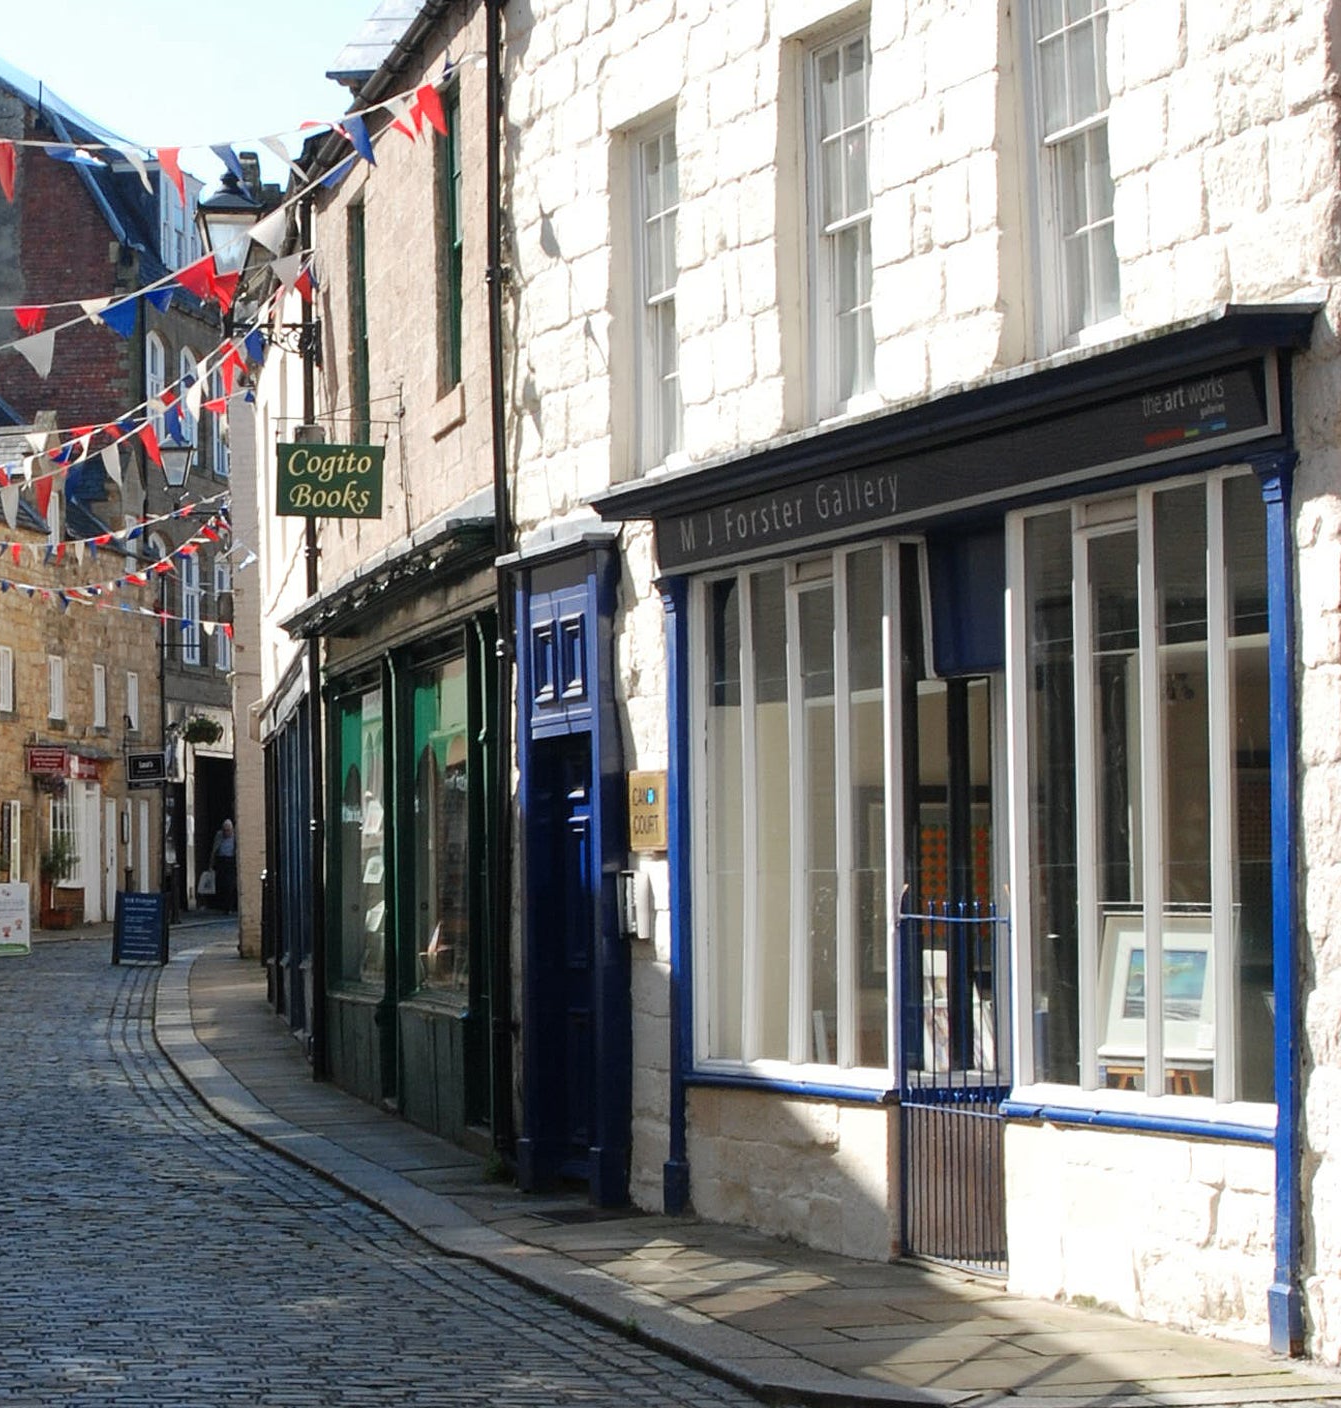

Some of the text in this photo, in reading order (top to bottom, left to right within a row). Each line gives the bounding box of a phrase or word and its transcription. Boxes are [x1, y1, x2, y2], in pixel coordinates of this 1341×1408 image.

[1142, 377, 1225, 417] the art works
[288, 448, 372, 482] Cogito
[289, 480, 370, 514] Books
[680, 473, 898, 551] M J Forster Gallery
[634, 814, 659, 835] COURT
